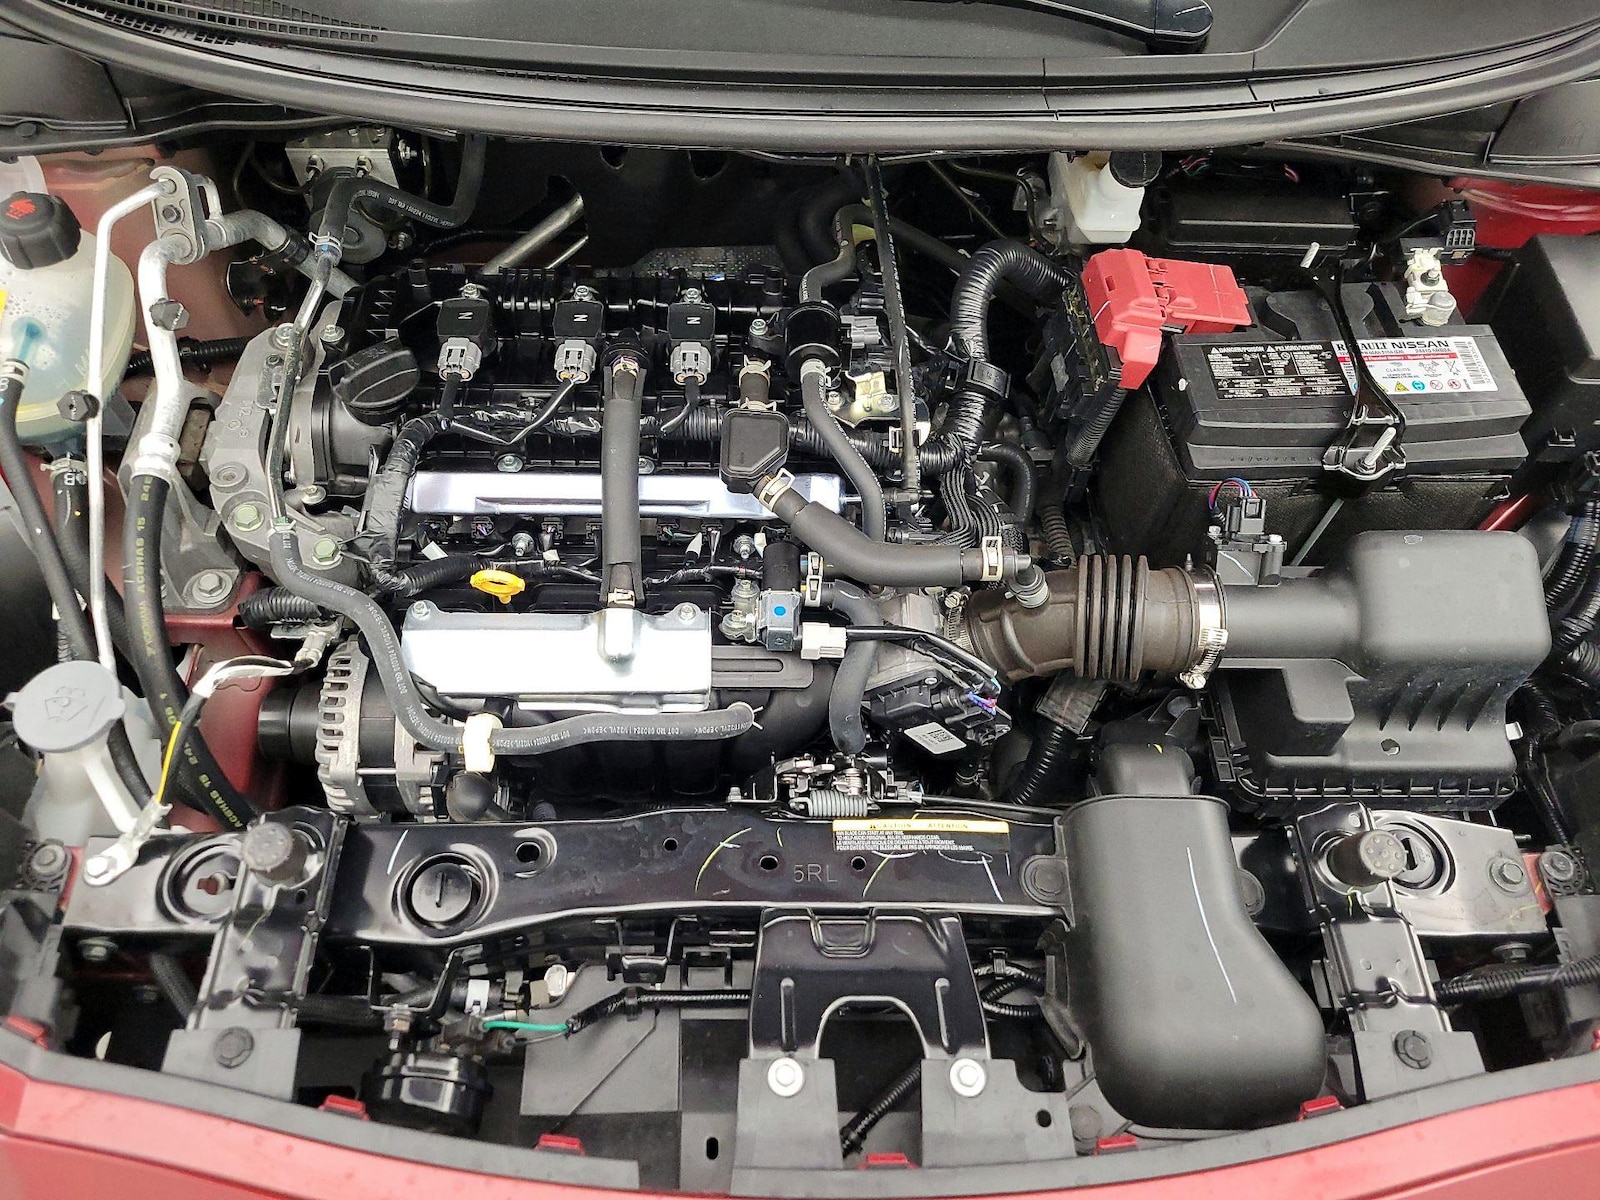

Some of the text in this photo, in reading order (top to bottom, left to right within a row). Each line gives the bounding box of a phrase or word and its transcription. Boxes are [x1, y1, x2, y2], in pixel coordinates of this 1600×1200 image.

[1337, 339, 1450, 352] RAULT NISSAN
[793, 864, 839, 883] 5RL
